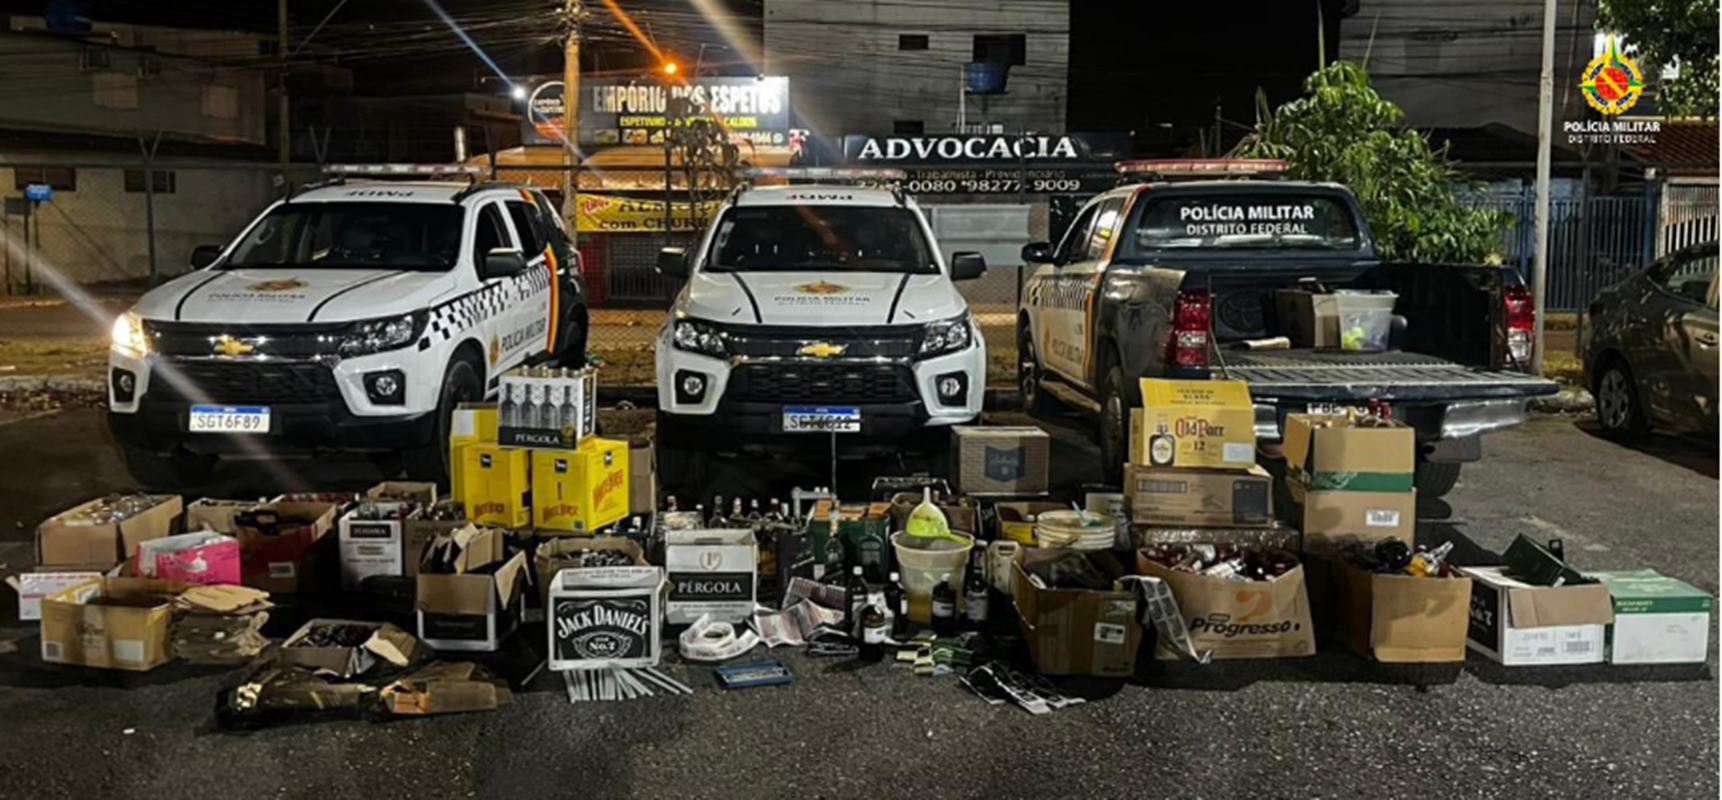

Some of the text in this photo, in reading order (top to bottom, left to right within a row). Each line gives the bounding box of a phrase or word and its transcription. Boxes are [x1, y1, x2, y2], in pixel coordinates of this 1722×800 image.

[711, 86, 783, 114] ESPETOS
[857, 136, 1078, 159] ADVOCACIA
[1033, 182, 1080, 193] 9009
[1180, 204, 1315, 221] POLÍCIA MILITAR
[599, 220, 637, 229] com
[1186, 222, 1308, 236] DISTRITO FEDERAL
[197, 415, 261, 429] SGT6F89
[1175, 418, 1225, 438] Old Parr
[1193, 441, 1206, 452] 12
[678, 579, 742, 593] PÉRGOLA
[557, 604, 651, 638] JACK DANIEL'S
[1189, 617, 1291, 638] Progresso
